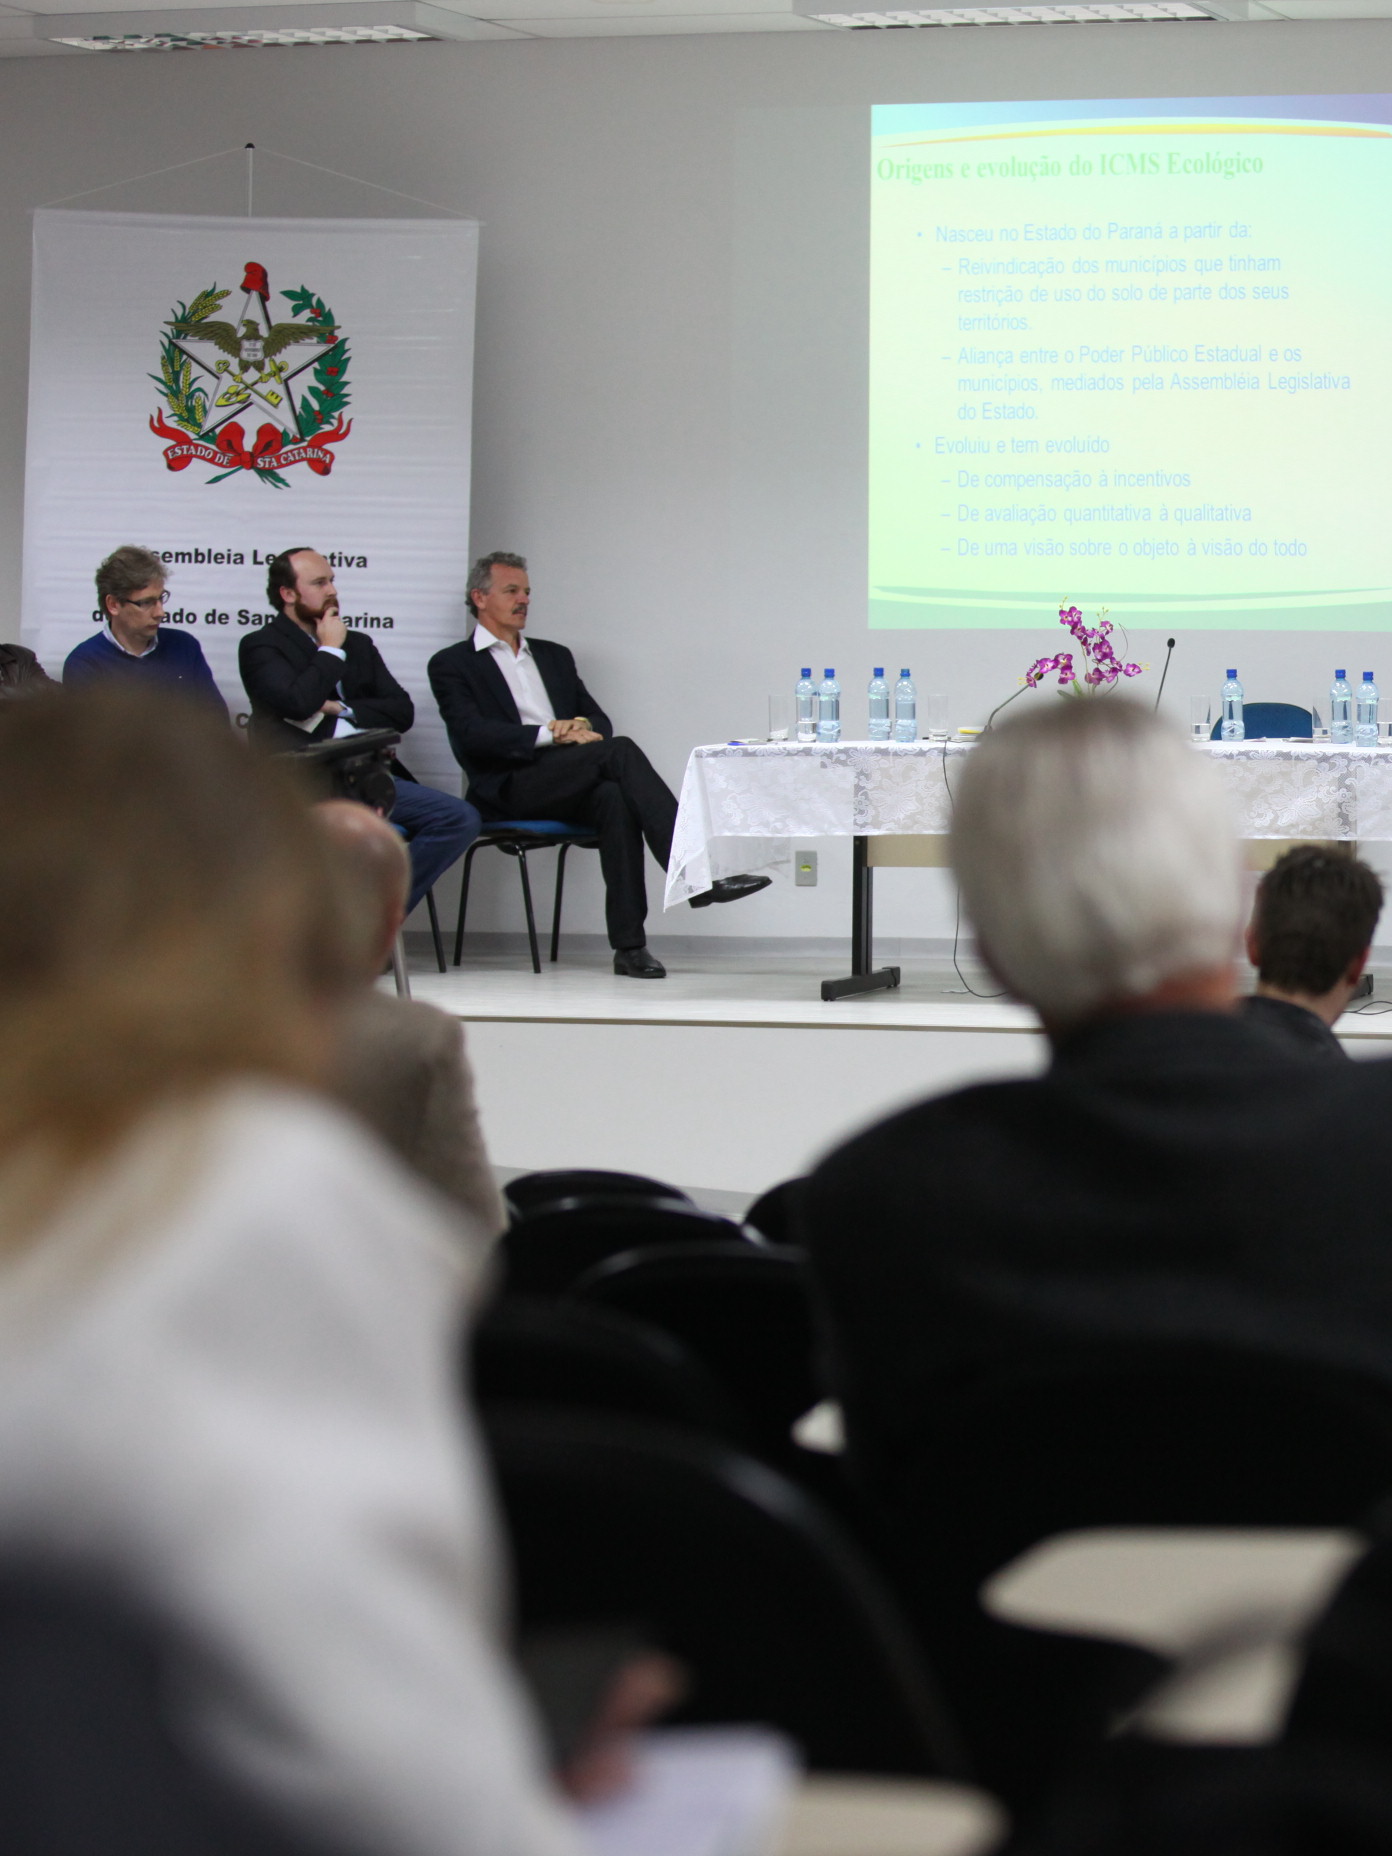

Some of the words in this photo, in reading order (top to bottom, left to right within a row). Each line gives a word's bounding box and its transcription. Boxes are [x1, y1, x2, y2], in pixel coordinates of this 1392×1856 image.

[877, 158, 954, 186] Origens
[960, 162, 971, 179] e
[976, 155, 1062, 182] evolução
[1068, 154, 1093, 176] do
[1100, 152, 1160, 176] ICMS
[1167, 151, 1263, 180] Ecológico
[935, 225, 994, 243] Nasceu
[999, 228, 1020, 241] no
[1024, 223, 1077, 241] Estado
[1082, 224, 1102, 240] do
[1107, 222, 1163, 240] Paraná
[1169, 225, 1179, 239] a
[1183, 222, 1223, 242] partir
[1229, 221, 1251, 238] da:
[958, 257, 1065, 278] Reivindicação
[1072, 256, 1100, 274] dos
[1104, 255, 1187, 276] municípios
[1194, 258, 1223, 275] que
[1228, 255, 1281, 271] tinham
[957, 285, 1024, 307] restrição
[1029, 285, 1049, 302] de
[1053, 288, 1082, 302] uso
[1086, 284, 1106, 301] do
[1111, 283, 1144, 301] solo
[1148, 284, 1168, 301] de
[1173, 284, 1212, 304] parte
[1218, 283, 1247, 300] dos
[1252, 286, 1290, 300] seus
[957, 314, 1032, 331] territórios.
[957, 346, 1014, 368] Aliança
[1019, 347, 1059, 364] entre
[1063, 349, 1075, 363] o
[1079, 345, 1125, 363] Poder
[1131, 344, 1189, 363] Público
[1194, 344, 1262, 362] Estadual
[1268, 348, 1279, 362] e
[1283, 347, 1302, 362] os
[957, 374, 1043, 395] municípios,
[1051, 373, 1124, 391] mediados
[1132, 373, 1164, 394] pela
[1170, 372, 1260, 390] Assembléia
[1268, 372, 1351, 394] Legislativa
[957, 403, 977, 420] do
[981, 401, 1038, 420] Estado.
[167, 444, 213, 460] ESTADO
[215, 454, 231, 466] DE
[280, 447, 332, 464] CATARINA
[934, 436, 991, 454] Evoluiu
[996, 440, 1006, 454] e
[1010, 437, 1039, 453] tem
[1045, 434, 1111, 453] evoluído
[957, 470, 980, 488] De
[984, 470, 1092, 492] compensação
[1098, 469, 1108, 487] à
[1114, 469, 1191, 487] incentivos
[957, 503, 980, 522] De
[984, 504, 1057, 525] avaliação
[1063, 504, 1152, 525] quantitativa
[1159, 504, 1168, 521] à
[1174, 504, 1252, 525] qualitativa
[253, 549, 368, 568] Letiva
[957, 538, 980, 556] De
[984, 542, 1018, 556] uma
[1024, 538, 1064, 556] visão
[1069, 539, 1112, 556] sobre
[1118, 541, 1129, 556] o
[1132, 538, 1179, 560] objeto
[1187, 538, 1197, 556] à
[1201, 538, 1244, 556] visão
[1248, 538, 1268, 556] do
[1273, 538, 1308, 556] todo
[160, 608, 197, 624] ado
[204, 608, 230, 625] de
[237, 609, 276, 626] San
[343, 612, 394, 629] arina
